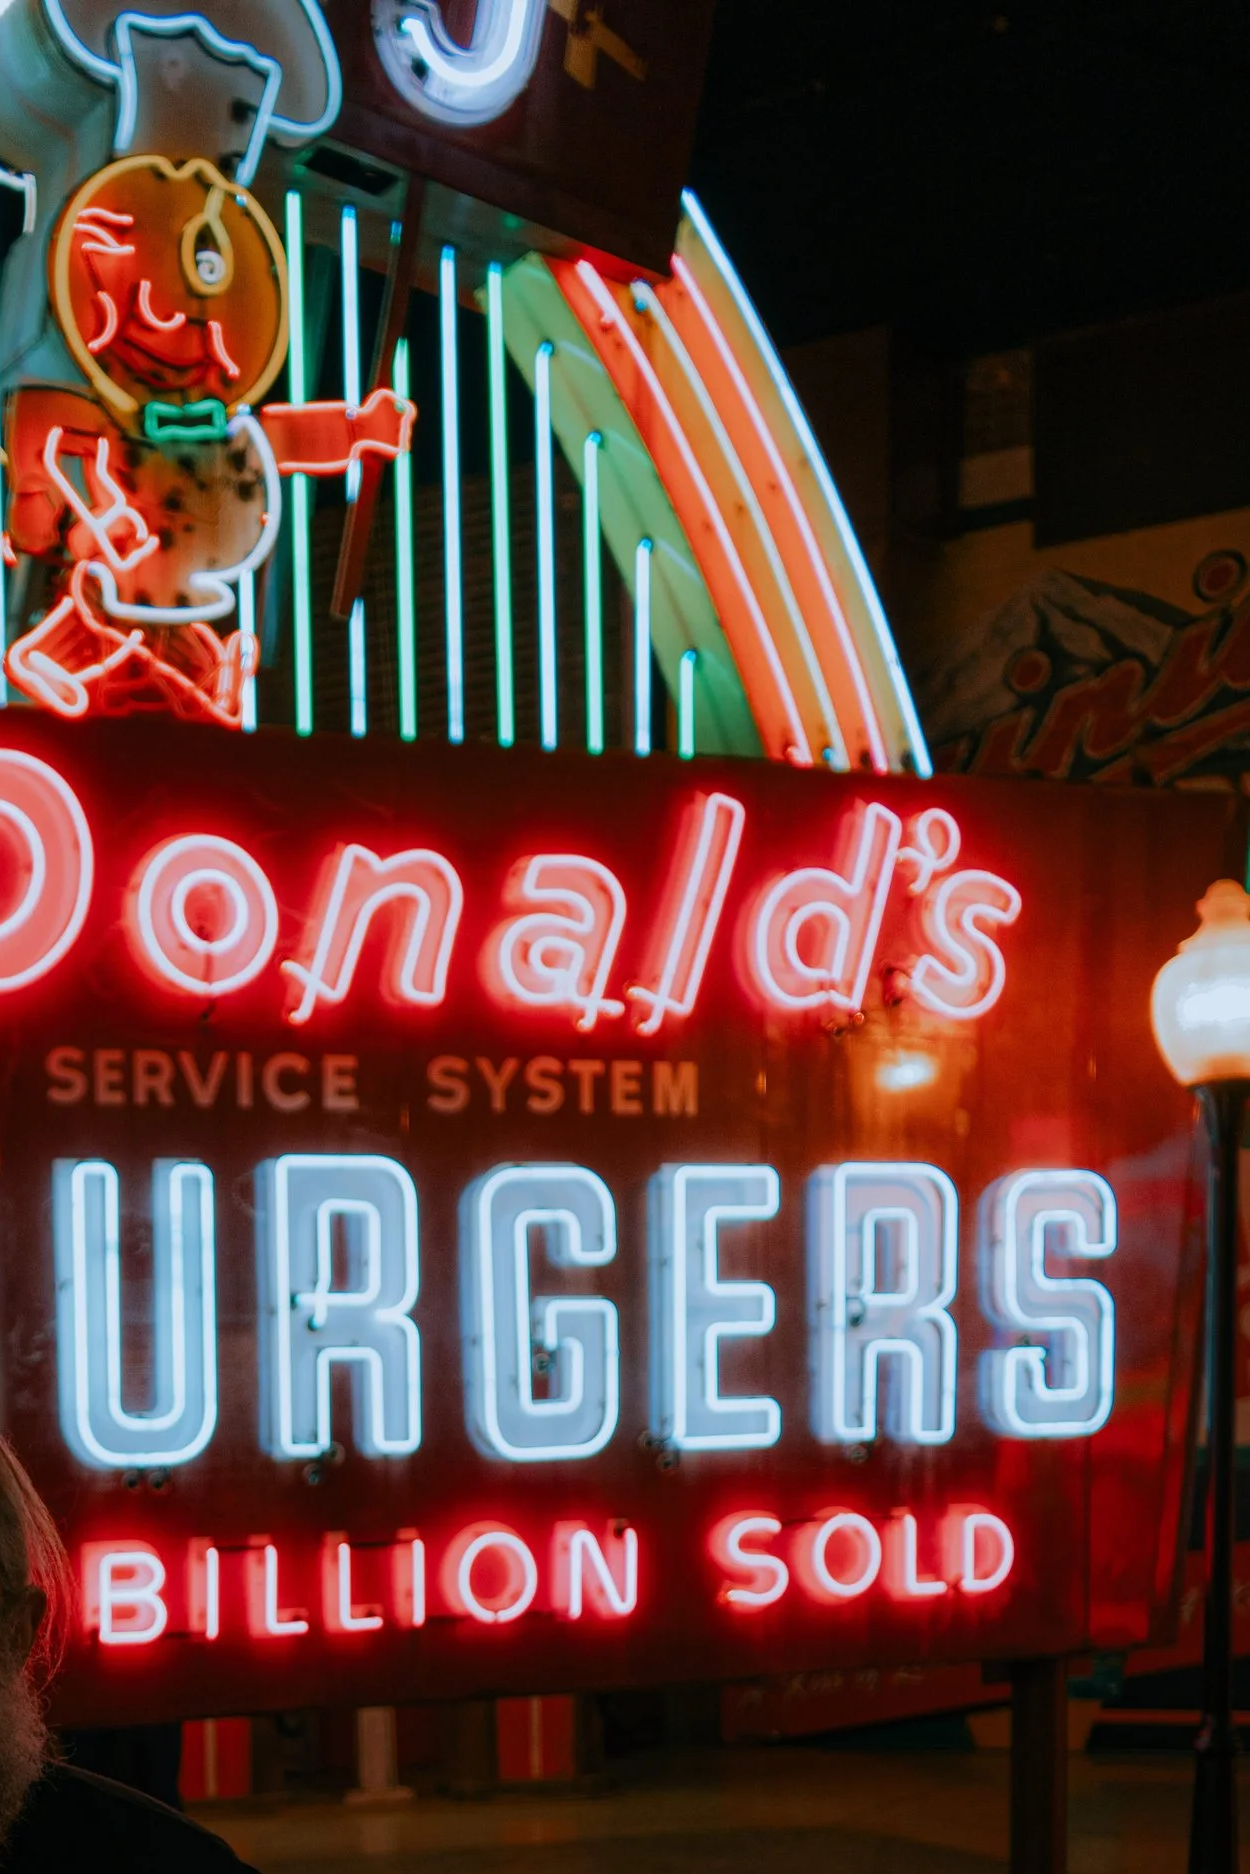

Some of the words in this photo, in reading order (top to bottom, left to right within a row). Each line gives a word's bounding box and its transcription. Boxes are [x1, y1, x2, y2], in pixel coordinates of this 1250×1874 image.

[46, 1044, 359, 1113] SERVICE
[426, 1053, 699, 1118] SYSTEM
[90, 1517, 640, 1646] BILLION
[710, 1506, 1015, 1606] SOLD
